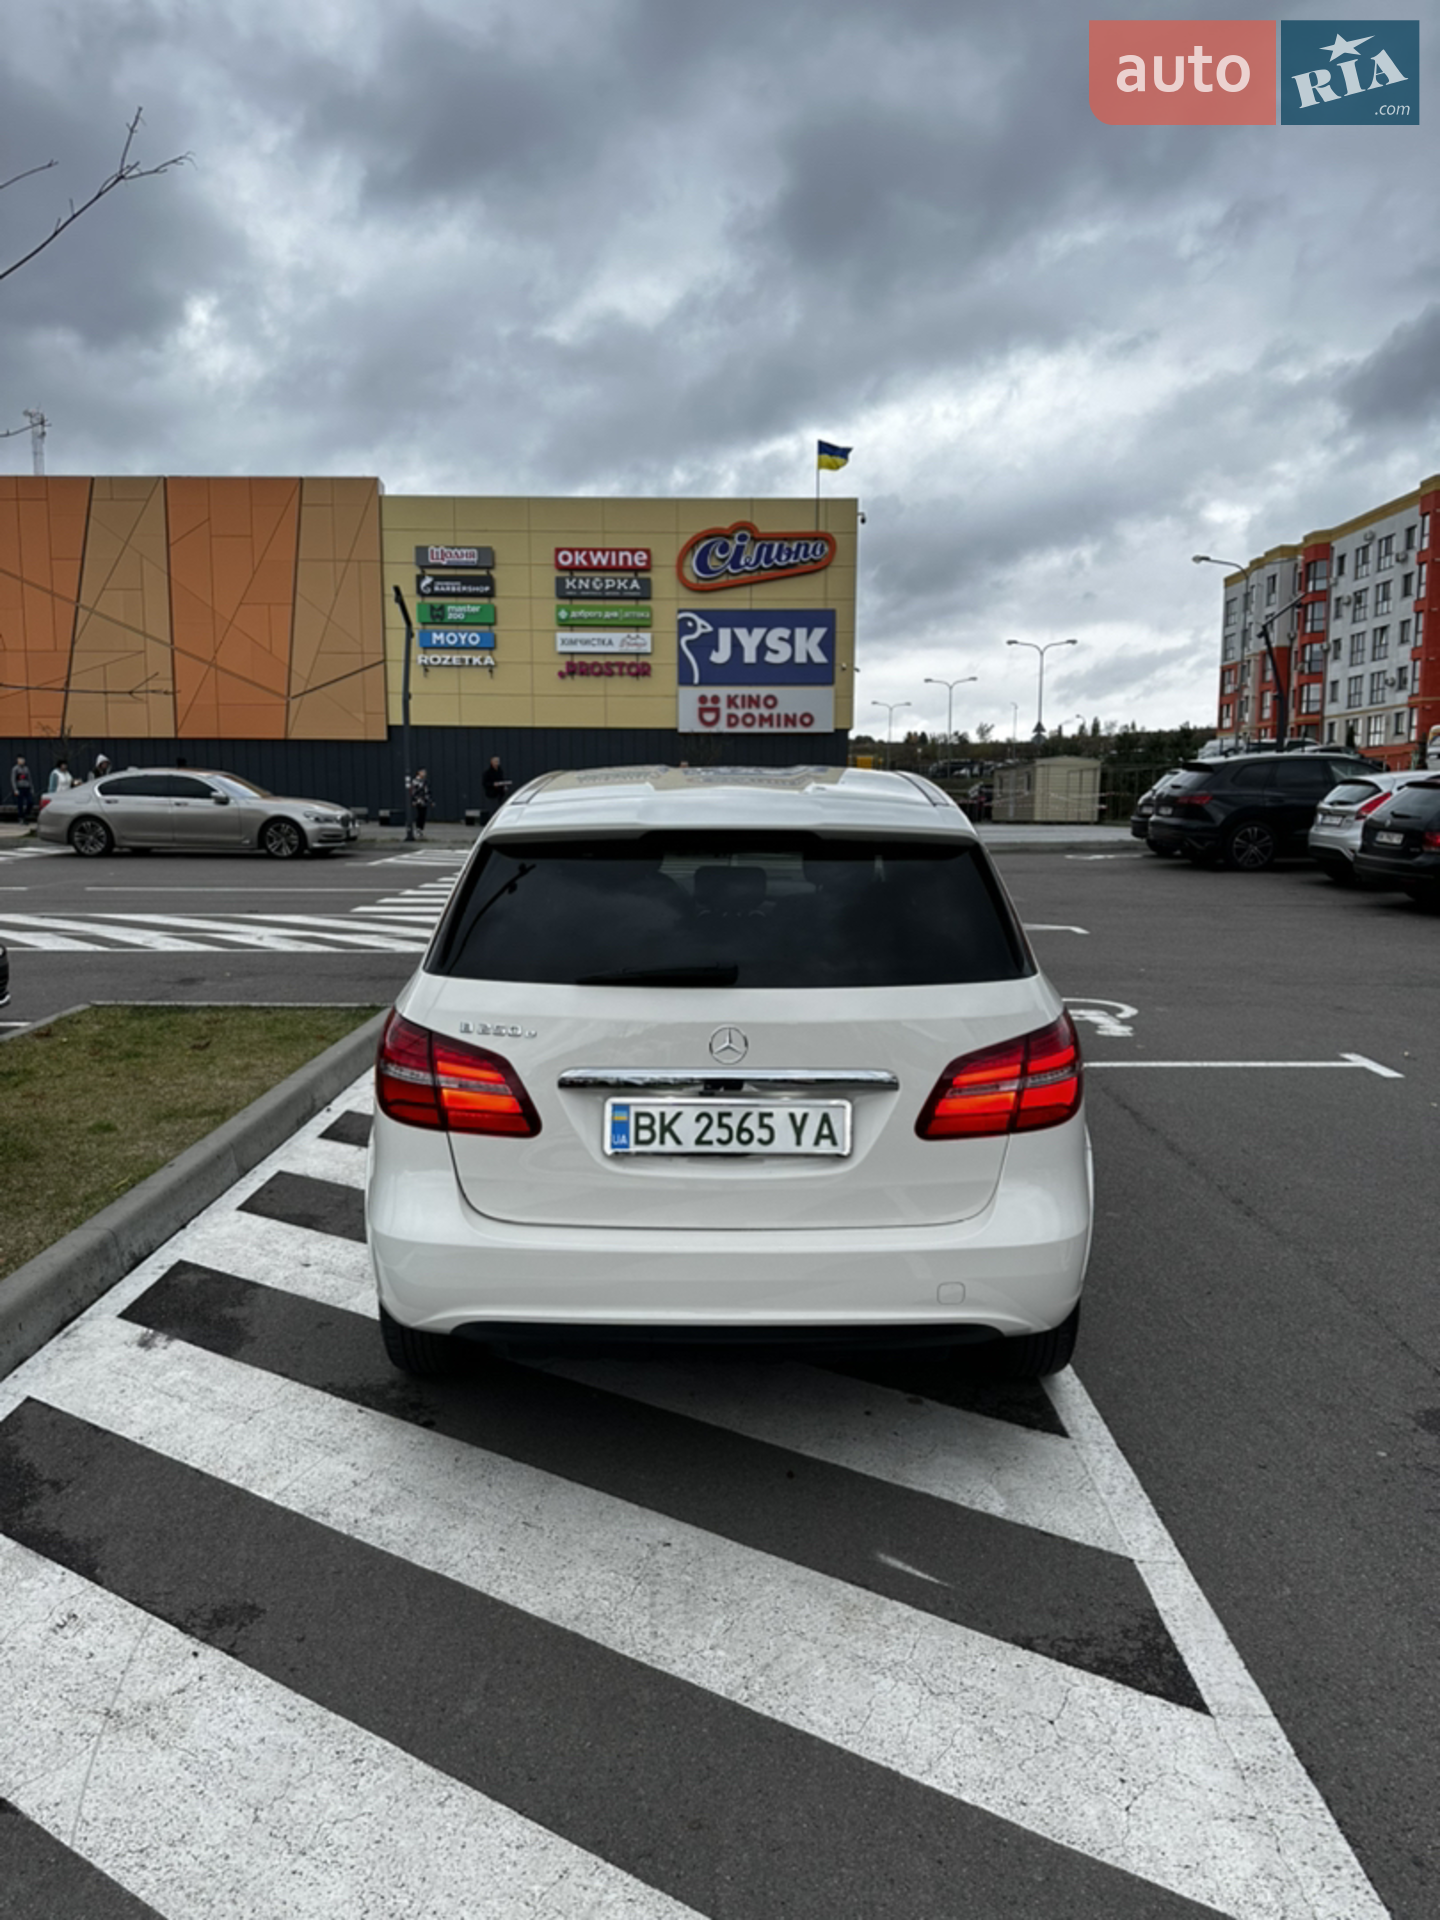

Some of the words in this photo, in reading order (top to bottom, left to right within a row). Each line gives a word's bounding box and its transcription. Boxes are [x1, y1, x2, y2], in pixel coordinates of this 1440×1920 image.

[692, 532, 829, 579] Сільпо
[433, 585, 490, 594] BARBERSHOP
[565, 577, 641, 591] KNOPKA
[447, 604, 481, 613] master
[431, 632, 480, 646] MOYO
[560, 638, 614, 647] ХІМЧИСТКА
[709, 627, 829, 664] JYSK
[417, 654, 495, 666] ROZETKA
[564, 661, 652, 677] PROSTOR
[726, 694, 779, 710] KINO
[726, 712, 815, 729] DOMINO
[633, 1111, 683, 1146] BK
[694, 1111, 776, 1146] 2565
[788, 1112, 839, 1147] YA
[612, 1134, 628, 1145] UA
